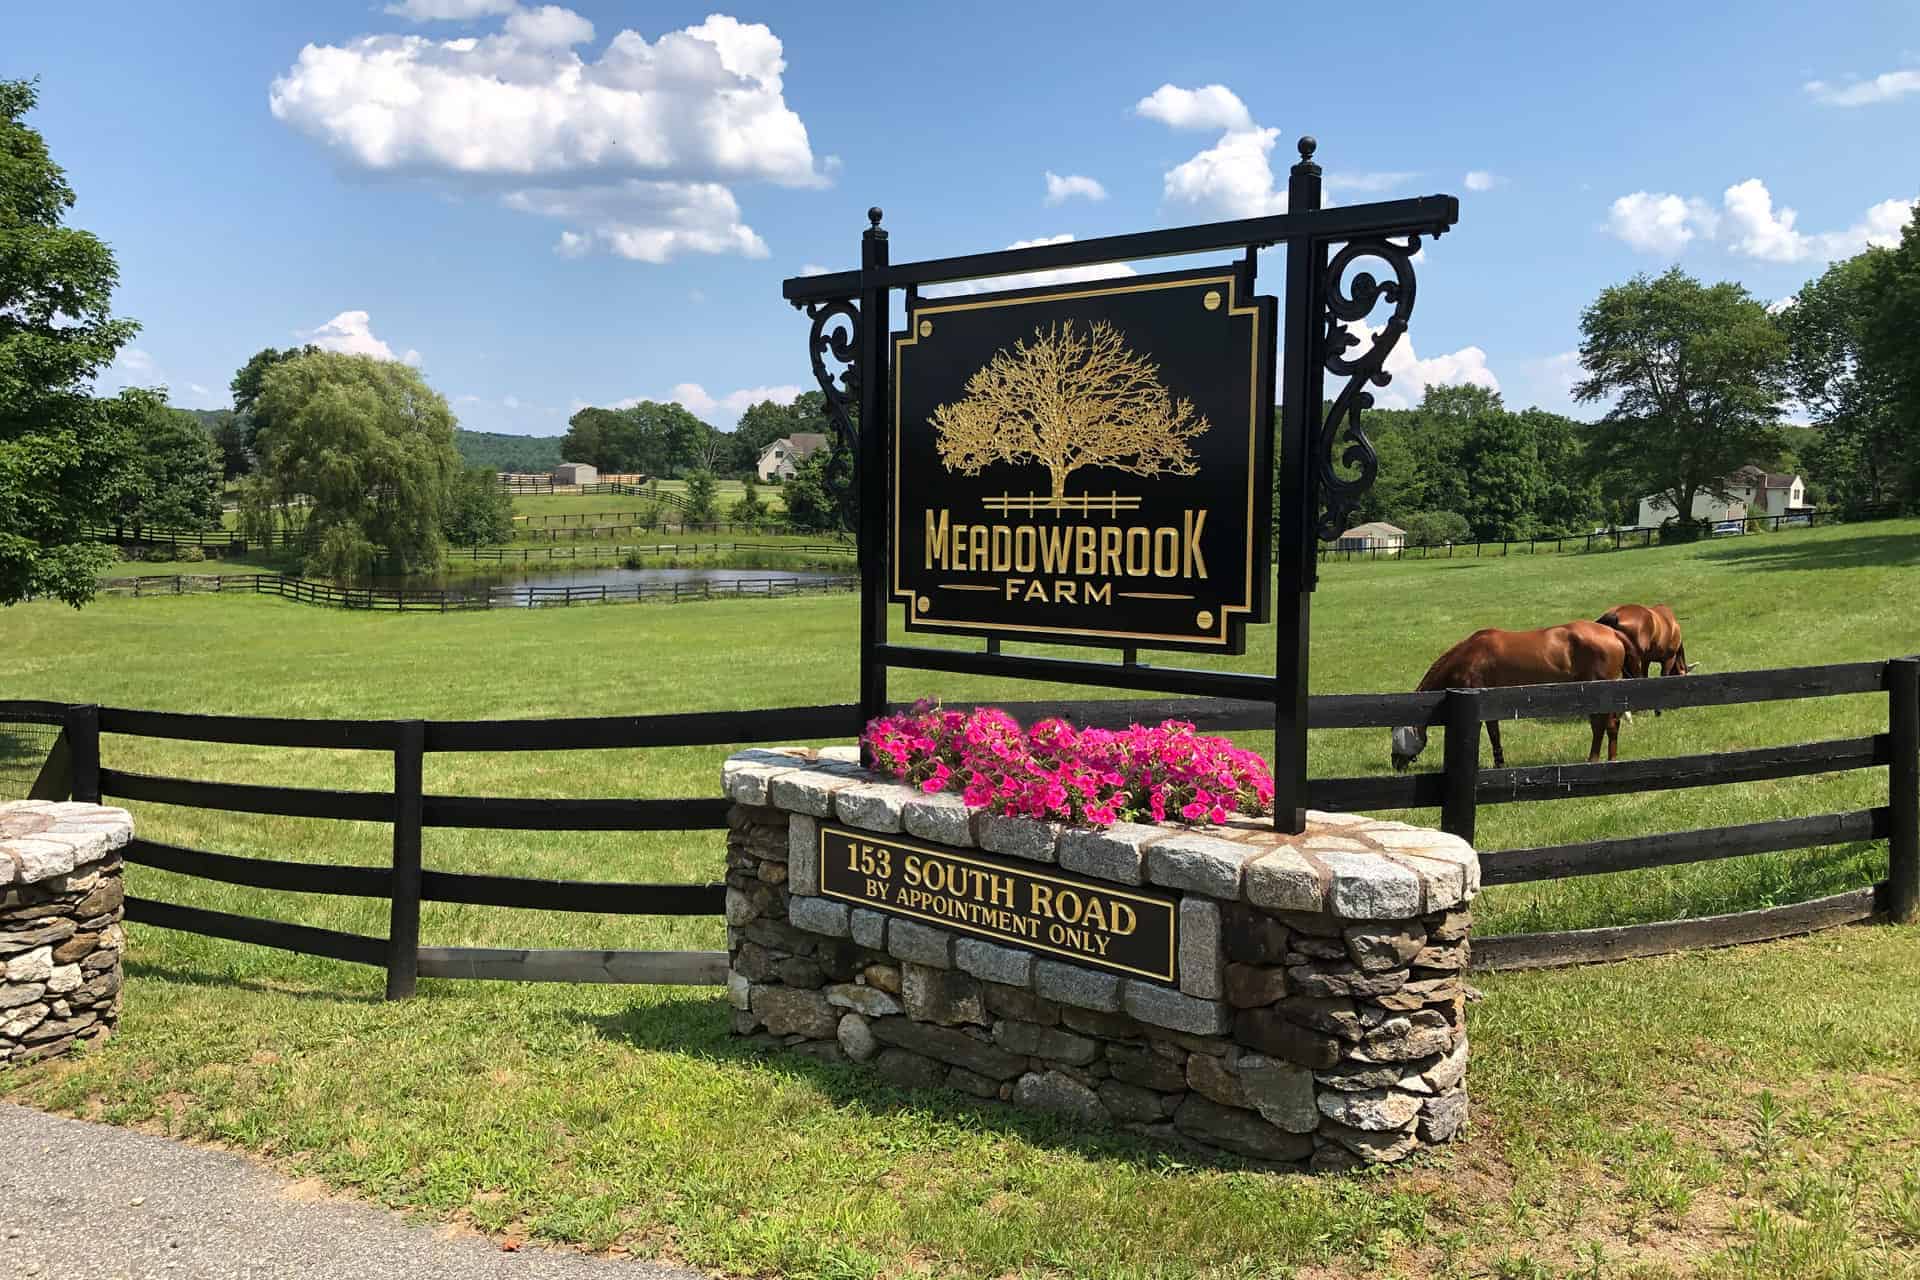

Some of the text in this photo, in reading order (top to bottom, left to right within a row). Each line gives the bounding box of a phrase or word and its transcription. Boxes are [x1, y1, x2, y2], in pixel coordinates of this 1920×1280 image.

[925, 508, 1209, 579] MEADOWBROOK
[1006, 578, 1112, 606] FARM
[847, 843, 1138, 936] 153 SOUTH ROAD
[866, 879, 1112, 956] BY APPOINTMENT ONLY
